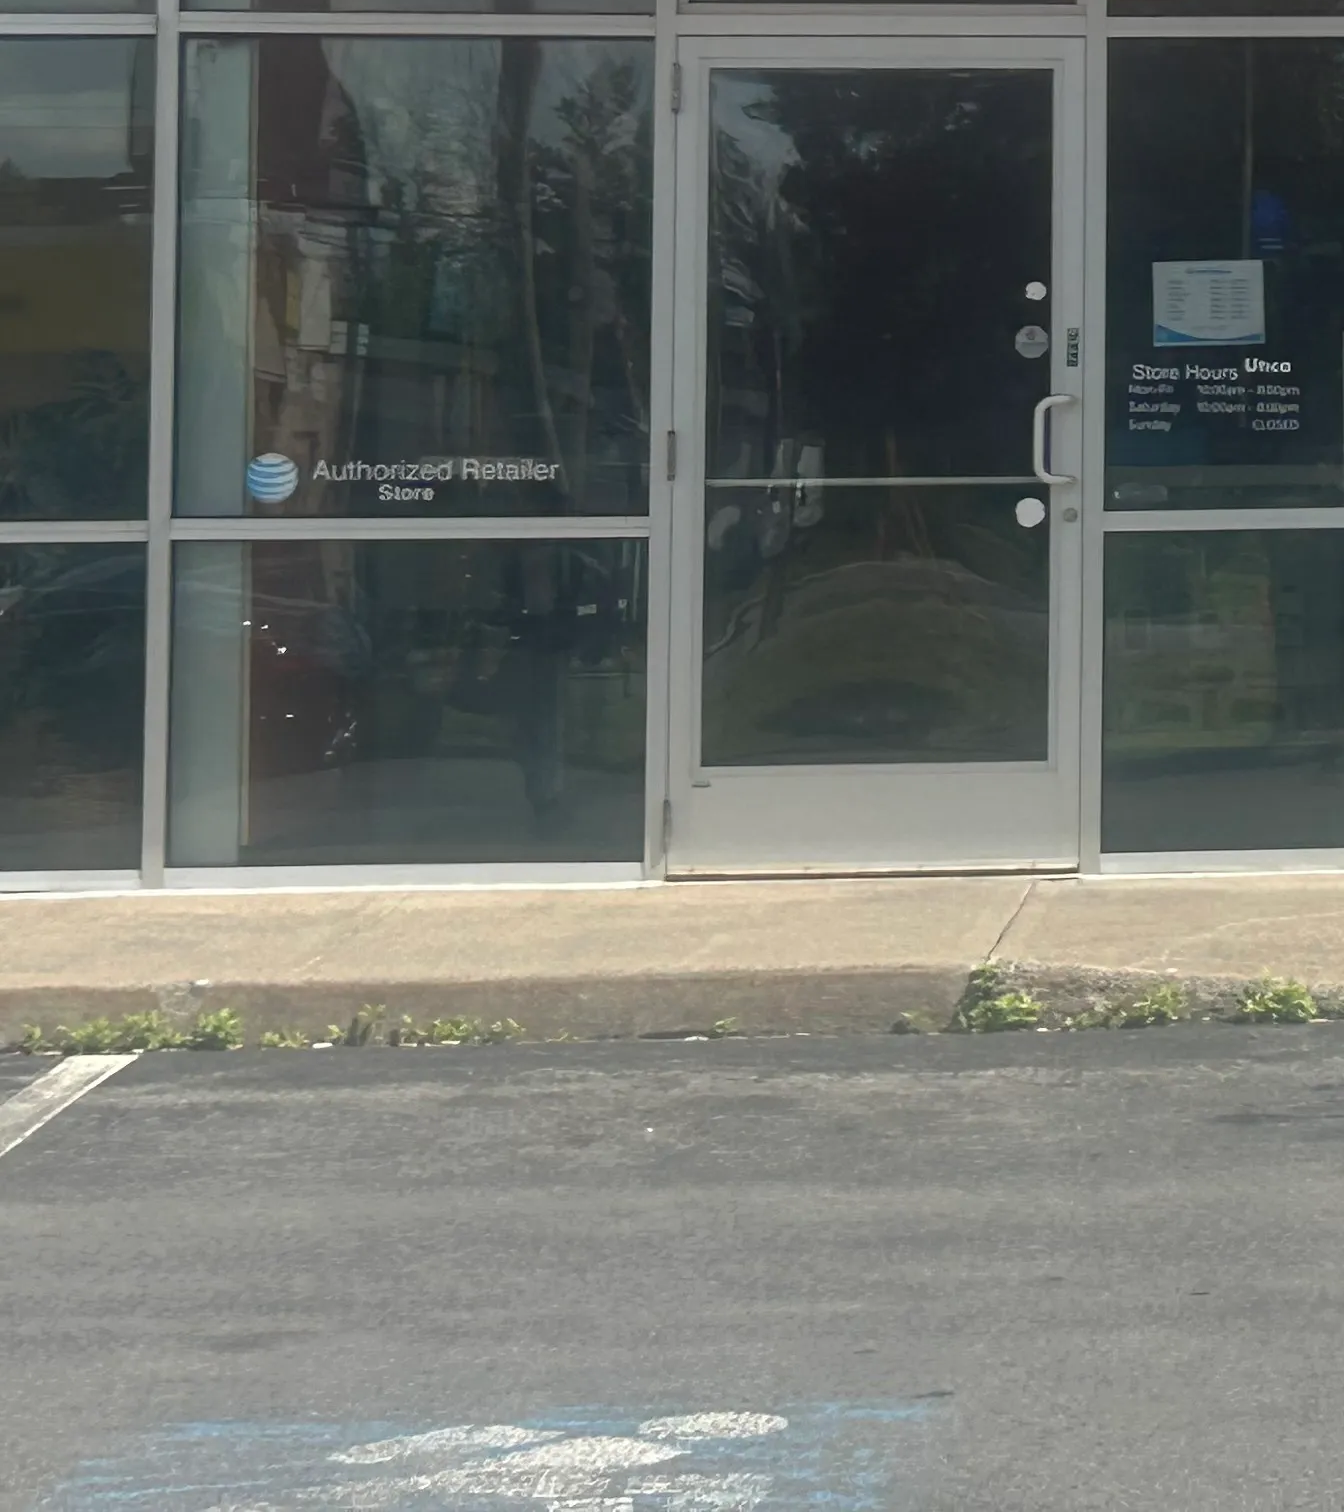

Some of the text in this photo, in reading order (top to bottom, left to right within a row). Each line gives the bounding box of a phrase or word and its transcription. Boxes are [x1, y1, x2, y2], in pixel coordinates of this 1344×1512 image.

[1132, 364, 1238, 381] Store Hours
[313, 457, 560, 481] Authorized Retailer
[378, 484, 435, 501] Store
